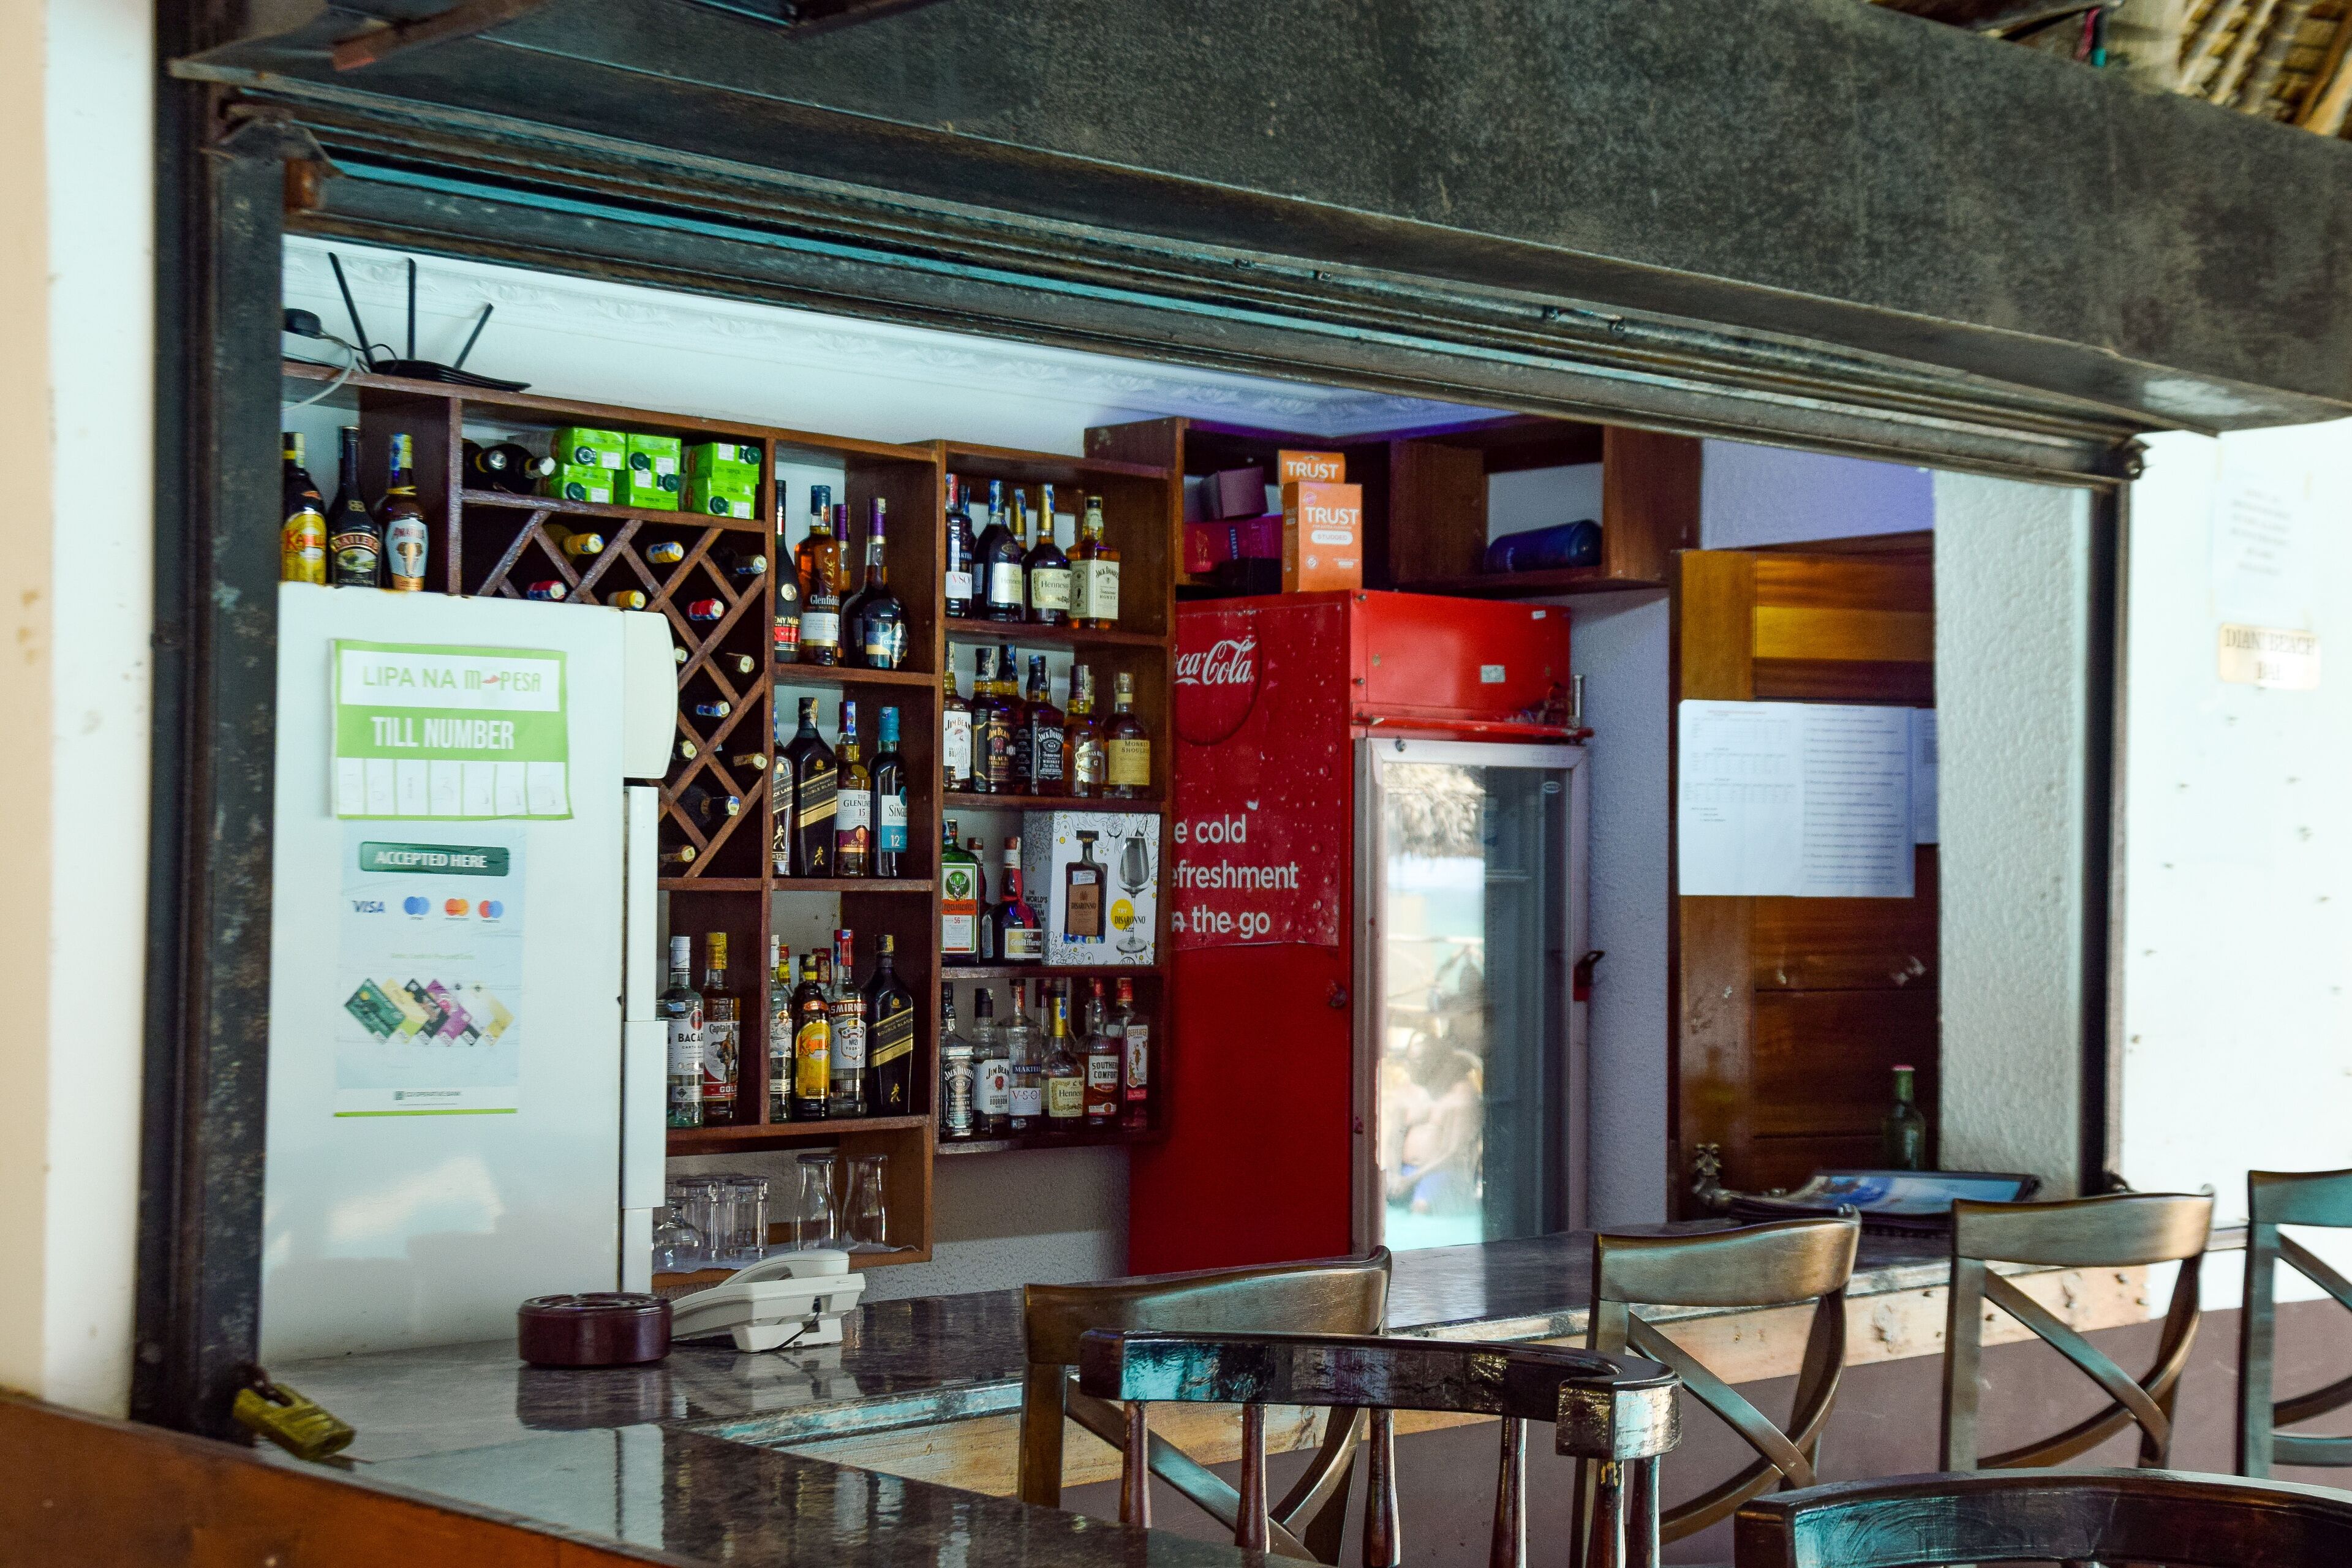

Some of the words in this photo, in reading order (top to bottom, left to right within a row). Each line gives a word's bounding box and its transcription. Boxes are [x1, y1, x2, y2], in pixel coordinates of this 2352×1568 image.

[1287, 461, 1339, 479] TRUST
[1305, 507, 1359, 525] TRUST
[1175, 639, 1256, 685] ca-Cola
[363, 666, 416, 687] LIPA
[422, 668, 457, 689] NA
[945, 719, 956, 731] JIM
[370, 716, 419, 747] TILL
[423, 718, 514, 750] NUMBER
[987, 729, 997, 741] JIM
[1038, 731, 1050, 742] JACK
[801, 788, 820, 798] DOUBLE
[1174, 821, 1188, 843] e
[1196, 813, 1246, 843] cold
[891, 835, 900, 846] 12
[374, 851, 449, 867] ACCEPTED
[450, 854, 488, 868] HERE
[352, 900, 385, 913] VISA
[1114, 916, 1146, 924] DISARONNO
[1191, 904, 1232, 933] the
[1238, 911, 1271, 940] go
[709, 1023, 731, 1035] Captain
[944, 1068, 957, 1080] JACK
[986, 1067, 997, 1080] JIM
